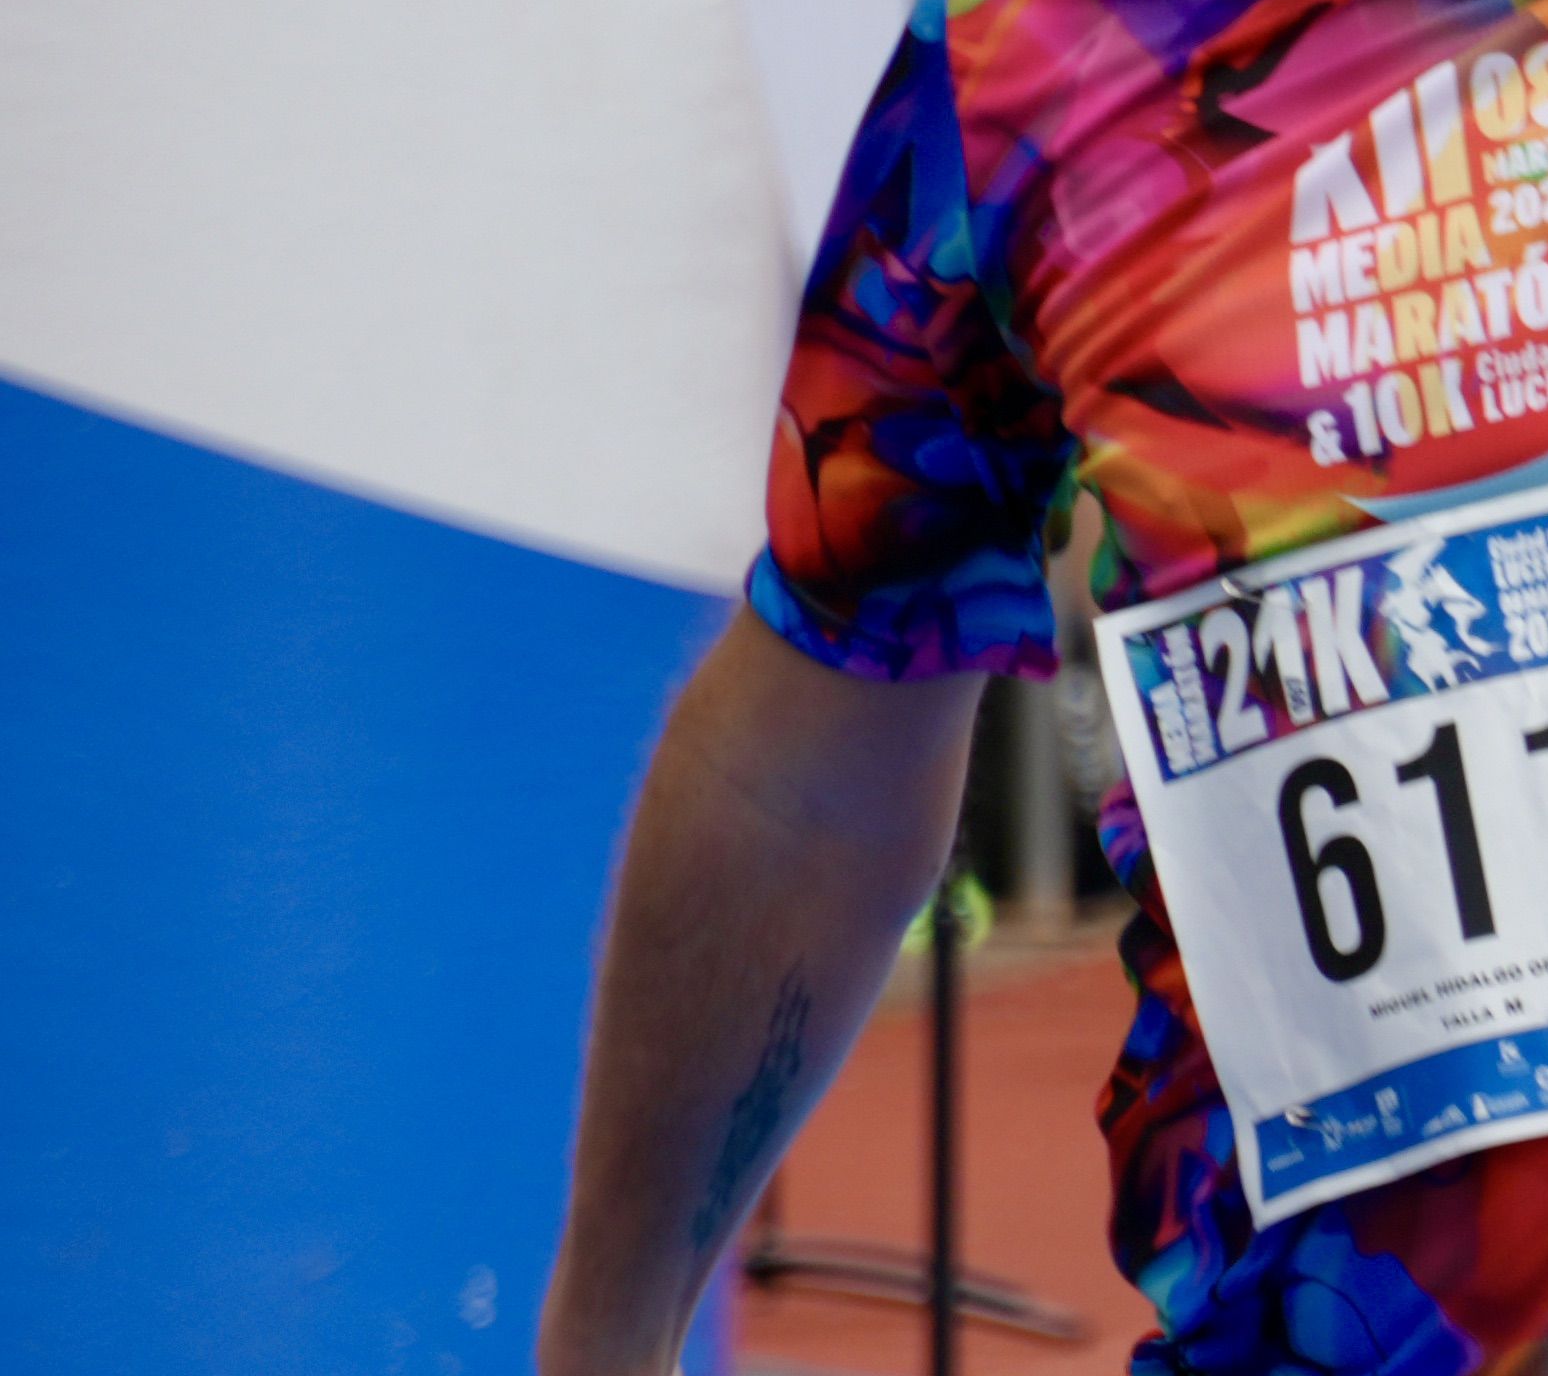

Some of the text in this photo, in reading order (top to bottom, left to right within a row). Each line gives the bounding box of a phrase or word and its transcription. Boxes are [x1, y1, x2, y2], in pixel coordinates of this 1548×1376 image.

[1289, 205, 1491, 315] MEDIA
[1305, 358, 1475, 467] & 10K
[1199, 569, 1388, 754] 21K
[1434, 965, 1524, 998] HIDALGO
[1440, 996, 1525, 1031] TALLA M
